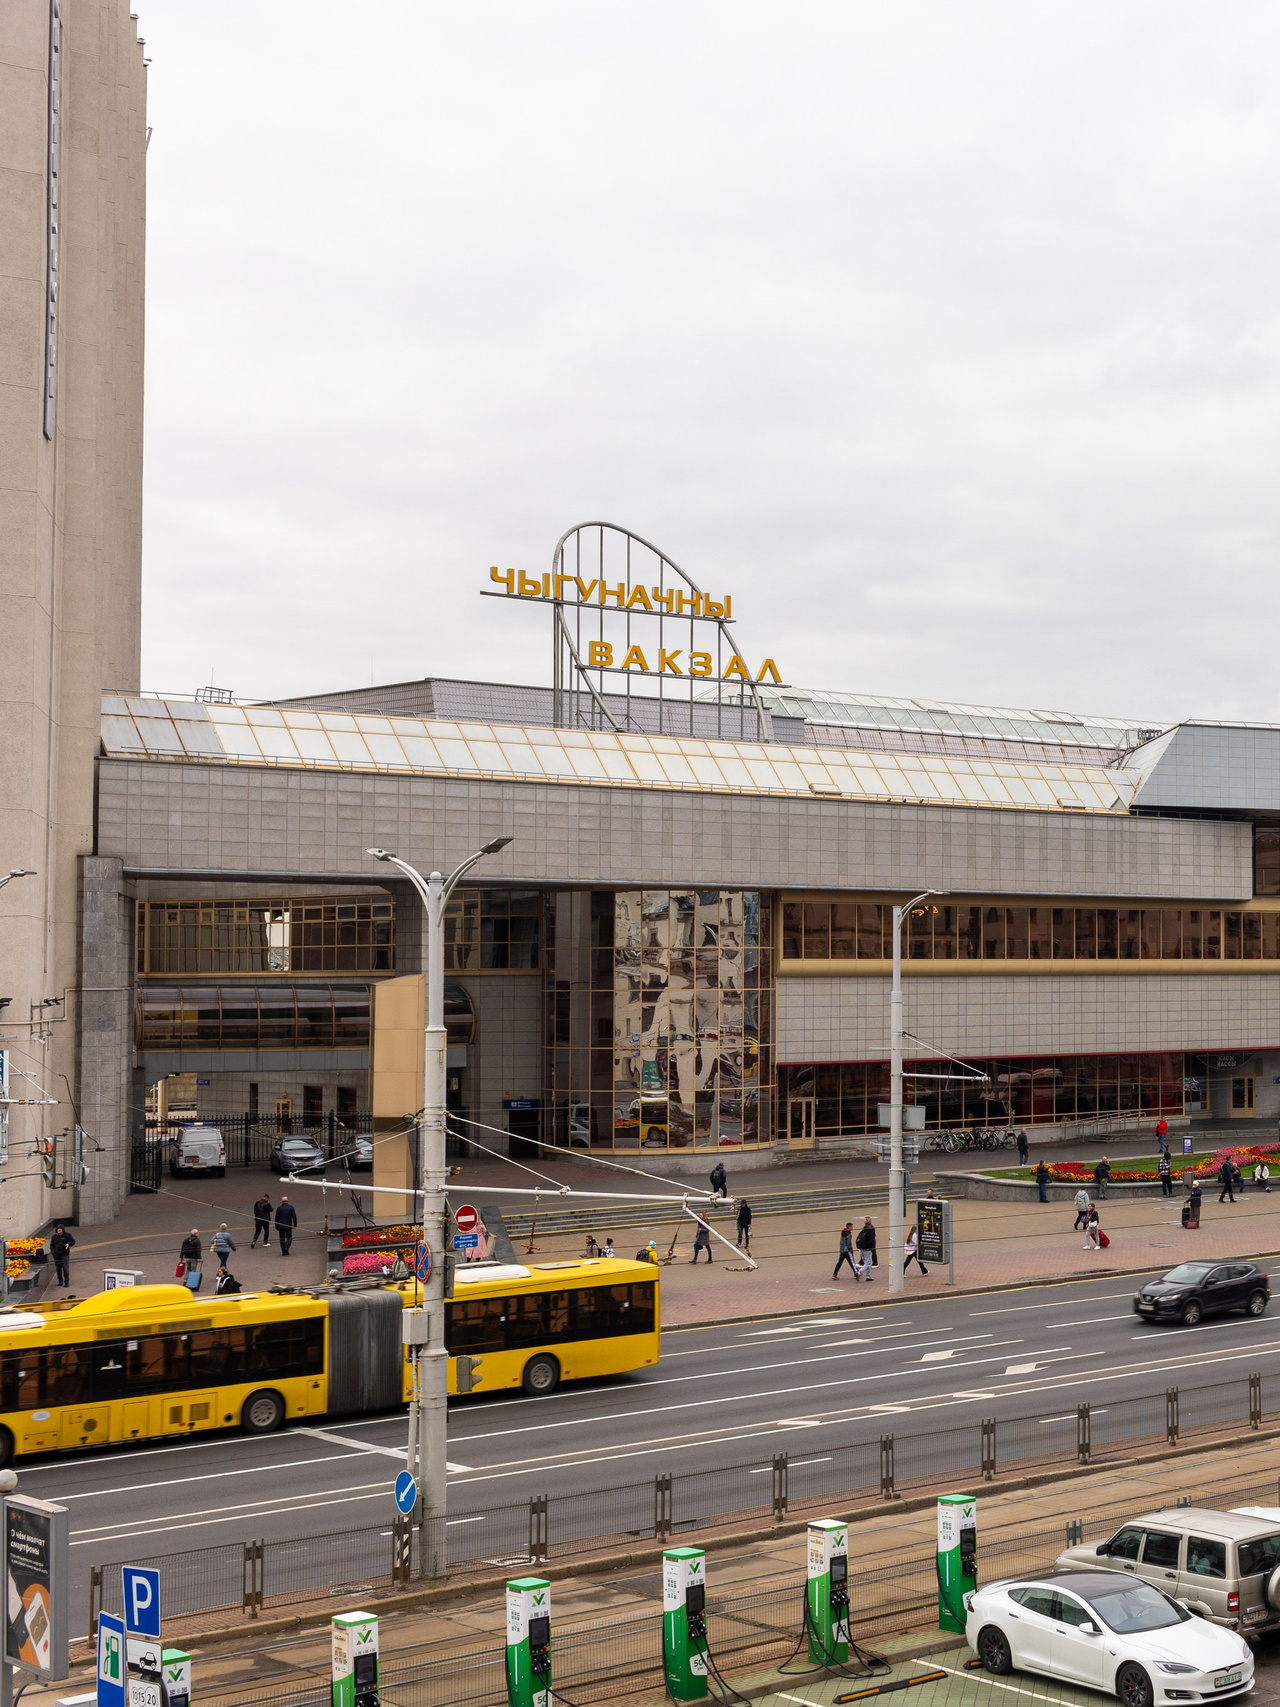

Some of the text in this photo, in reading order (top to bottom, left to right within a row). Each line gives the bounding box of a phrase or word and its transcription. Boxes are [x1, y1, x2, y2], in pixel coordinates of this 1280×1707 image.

[490, 566, 732, 619] ЧЫГУНАЧНЫ
[588, 640, 783, 683] ВАКЗАЛ
[15, 1531, 27, 1541] чём
[26, 1535, 46, 1547] молчат
[10, 1540, 40, 1556] смартфоны
[131, 1575, 153, 1626] P
[173, 1663, 178, 1671] 1
[693, 1658, 704, 1668] 50
[138, 1692, 145, 1704] 15
[147, 1693, 157, 1706] 20
